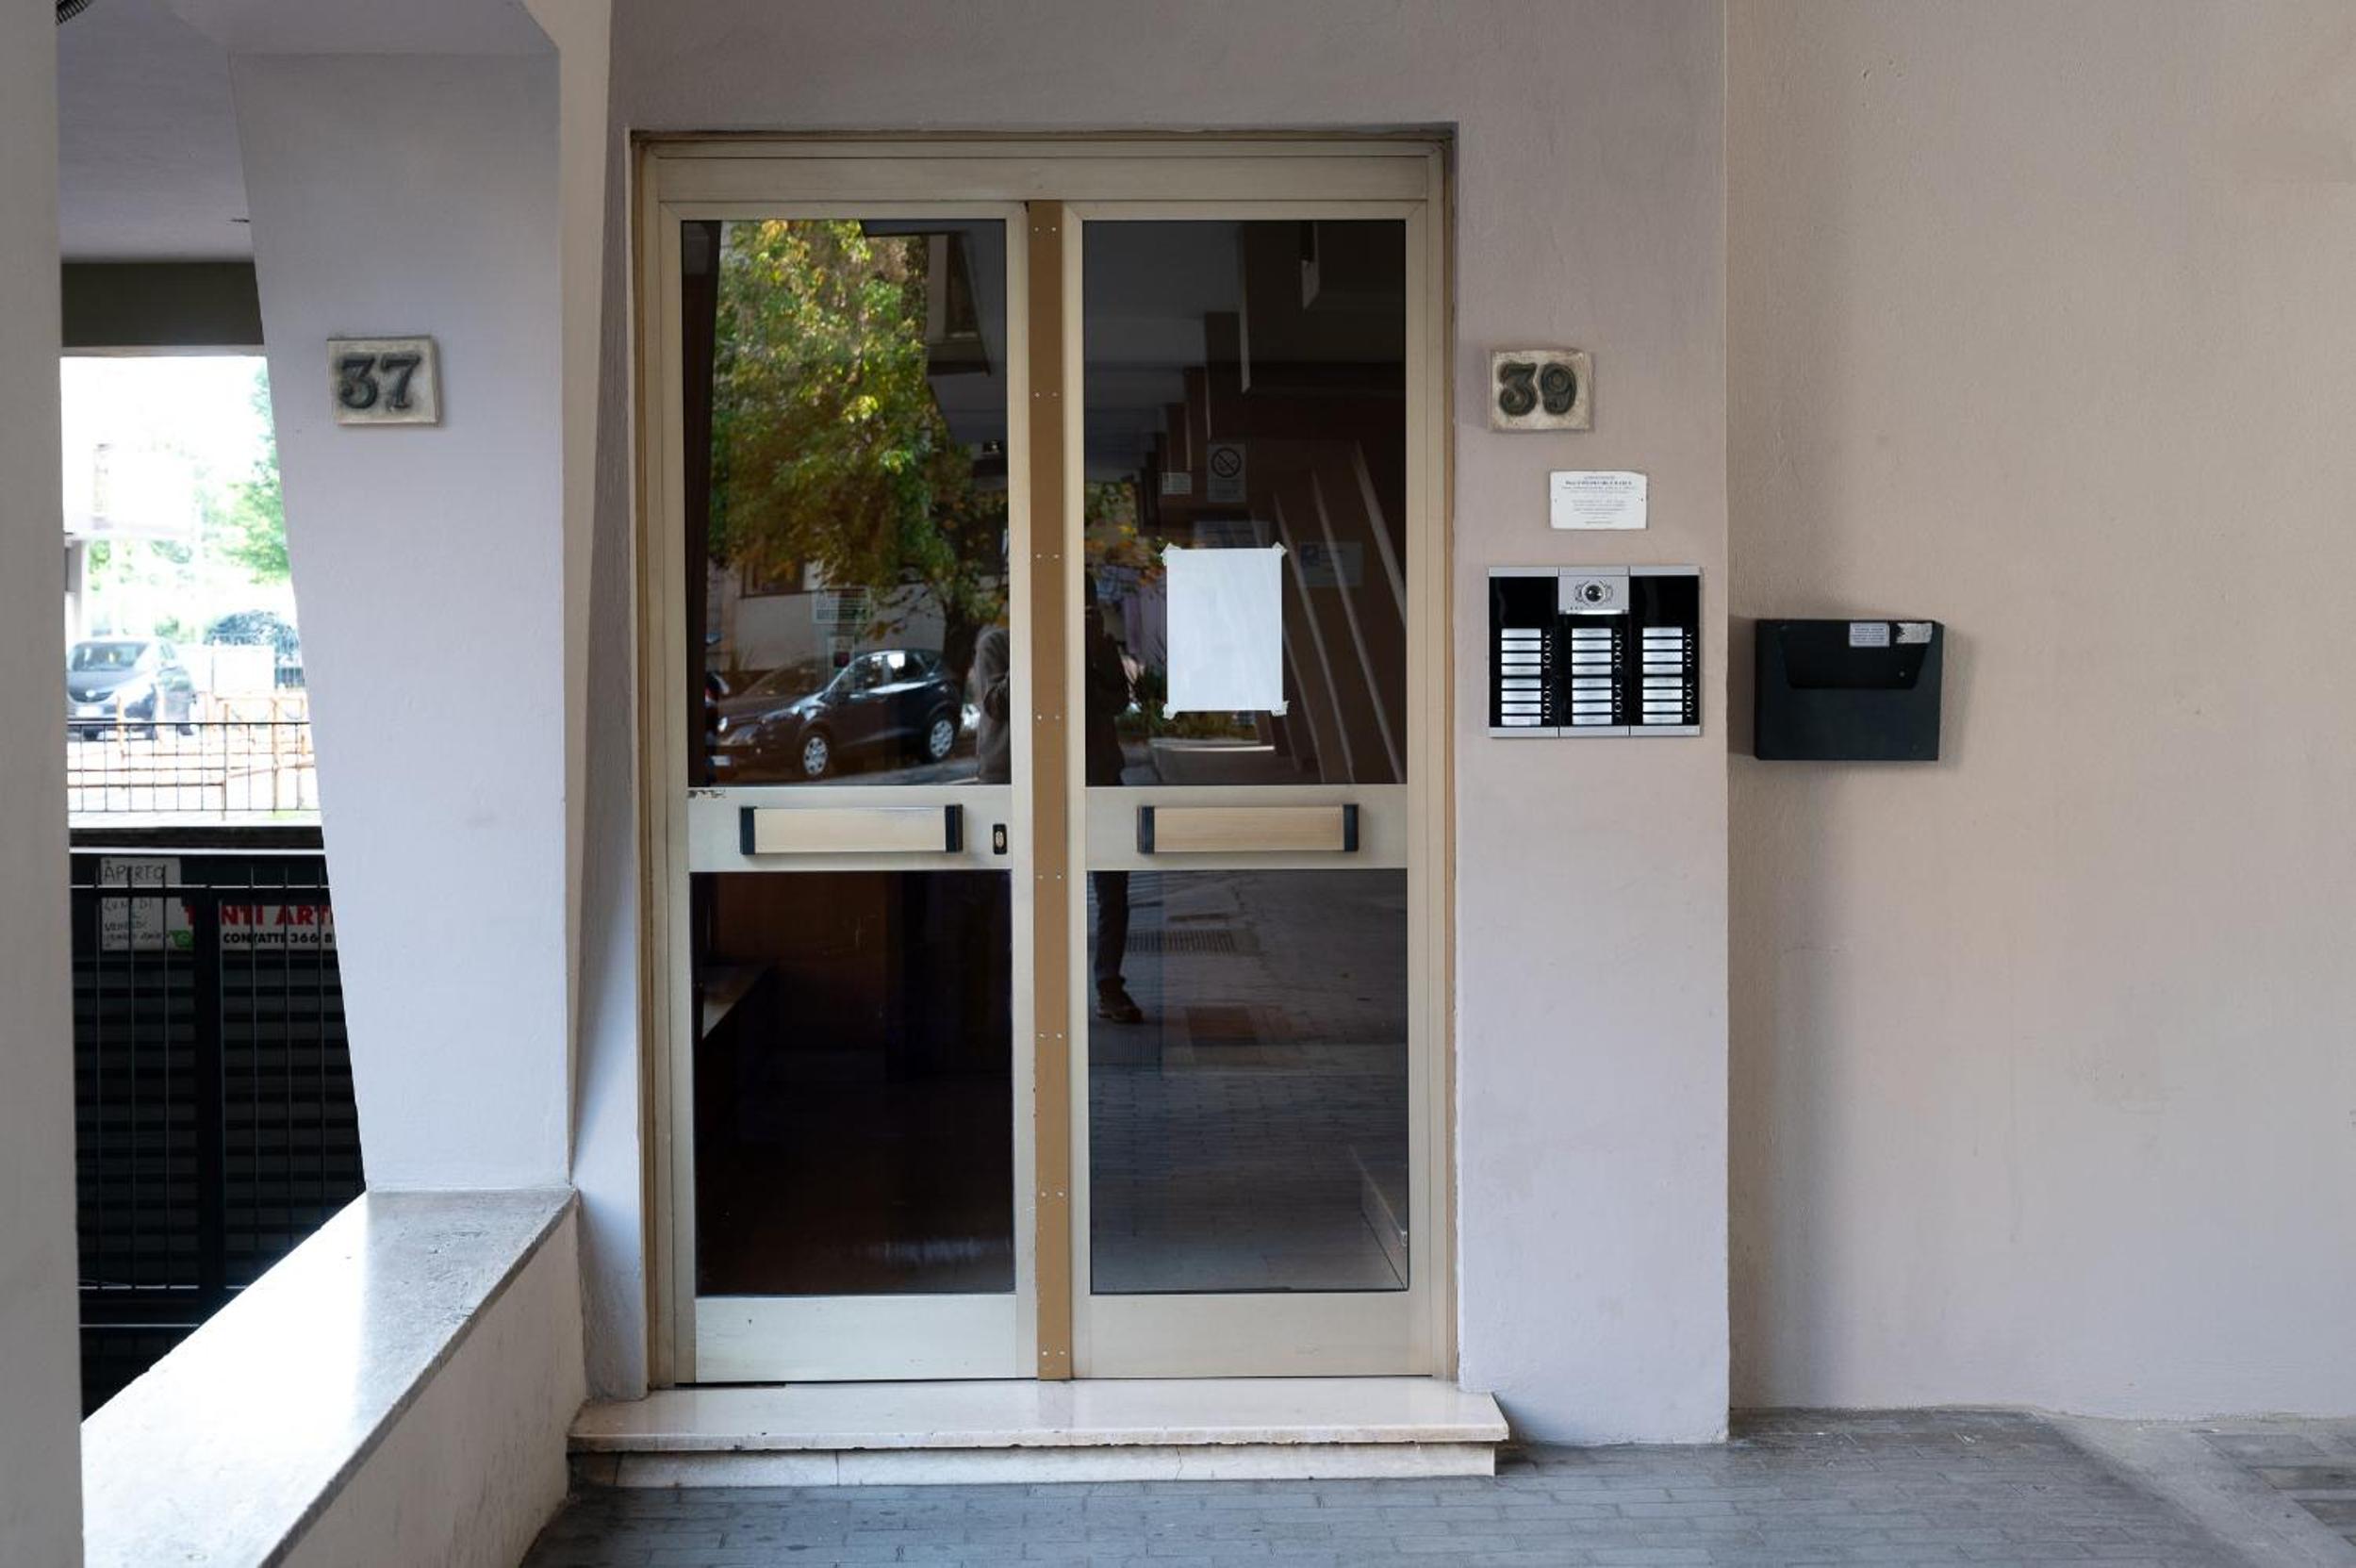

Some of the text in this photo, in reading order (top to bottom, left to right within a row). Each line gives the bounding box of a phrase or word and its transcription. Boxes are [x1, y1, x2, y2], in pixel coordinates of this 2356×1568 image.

[338, 353, 421, 410] 37
[1497, 361, 1578, 417] 39
[105, 865, 165, 881] APRTO
[275, 905, 333, 925] ART
